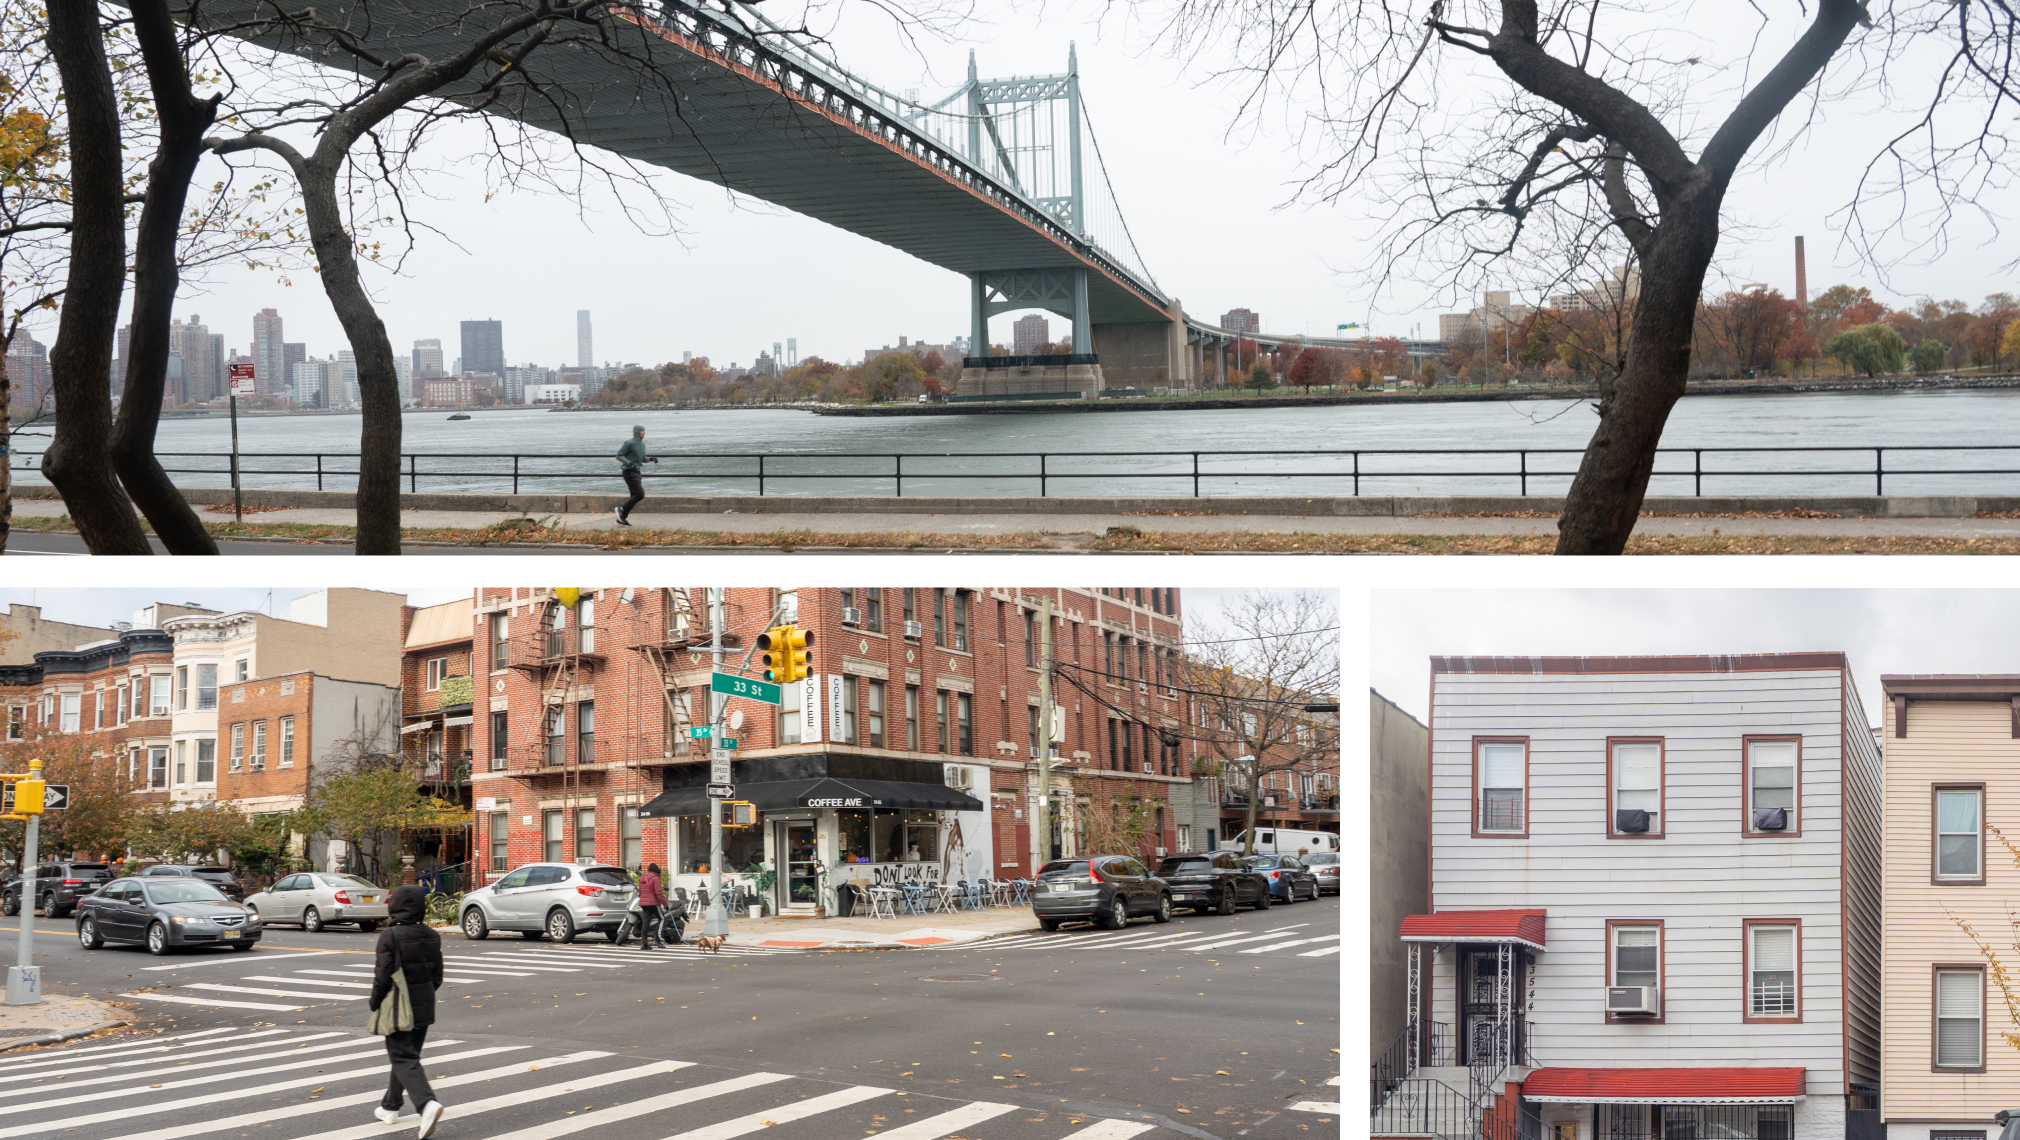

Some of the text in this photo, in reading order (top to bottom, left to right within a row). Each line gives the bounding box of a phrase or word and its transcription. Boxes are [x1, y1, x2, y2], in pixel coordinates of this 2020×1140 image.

[733, 681, 762, 696] 33 St
[806, 678, 814, 727] COFFEE
[696, 728, 702, 736] 35
[4, 792, 15, 800] ON
[808, 798, 862, 807] COFFEE AVE
[904, 864, 922, 879] LOOK
[926, 865, 939, 879] FOR
